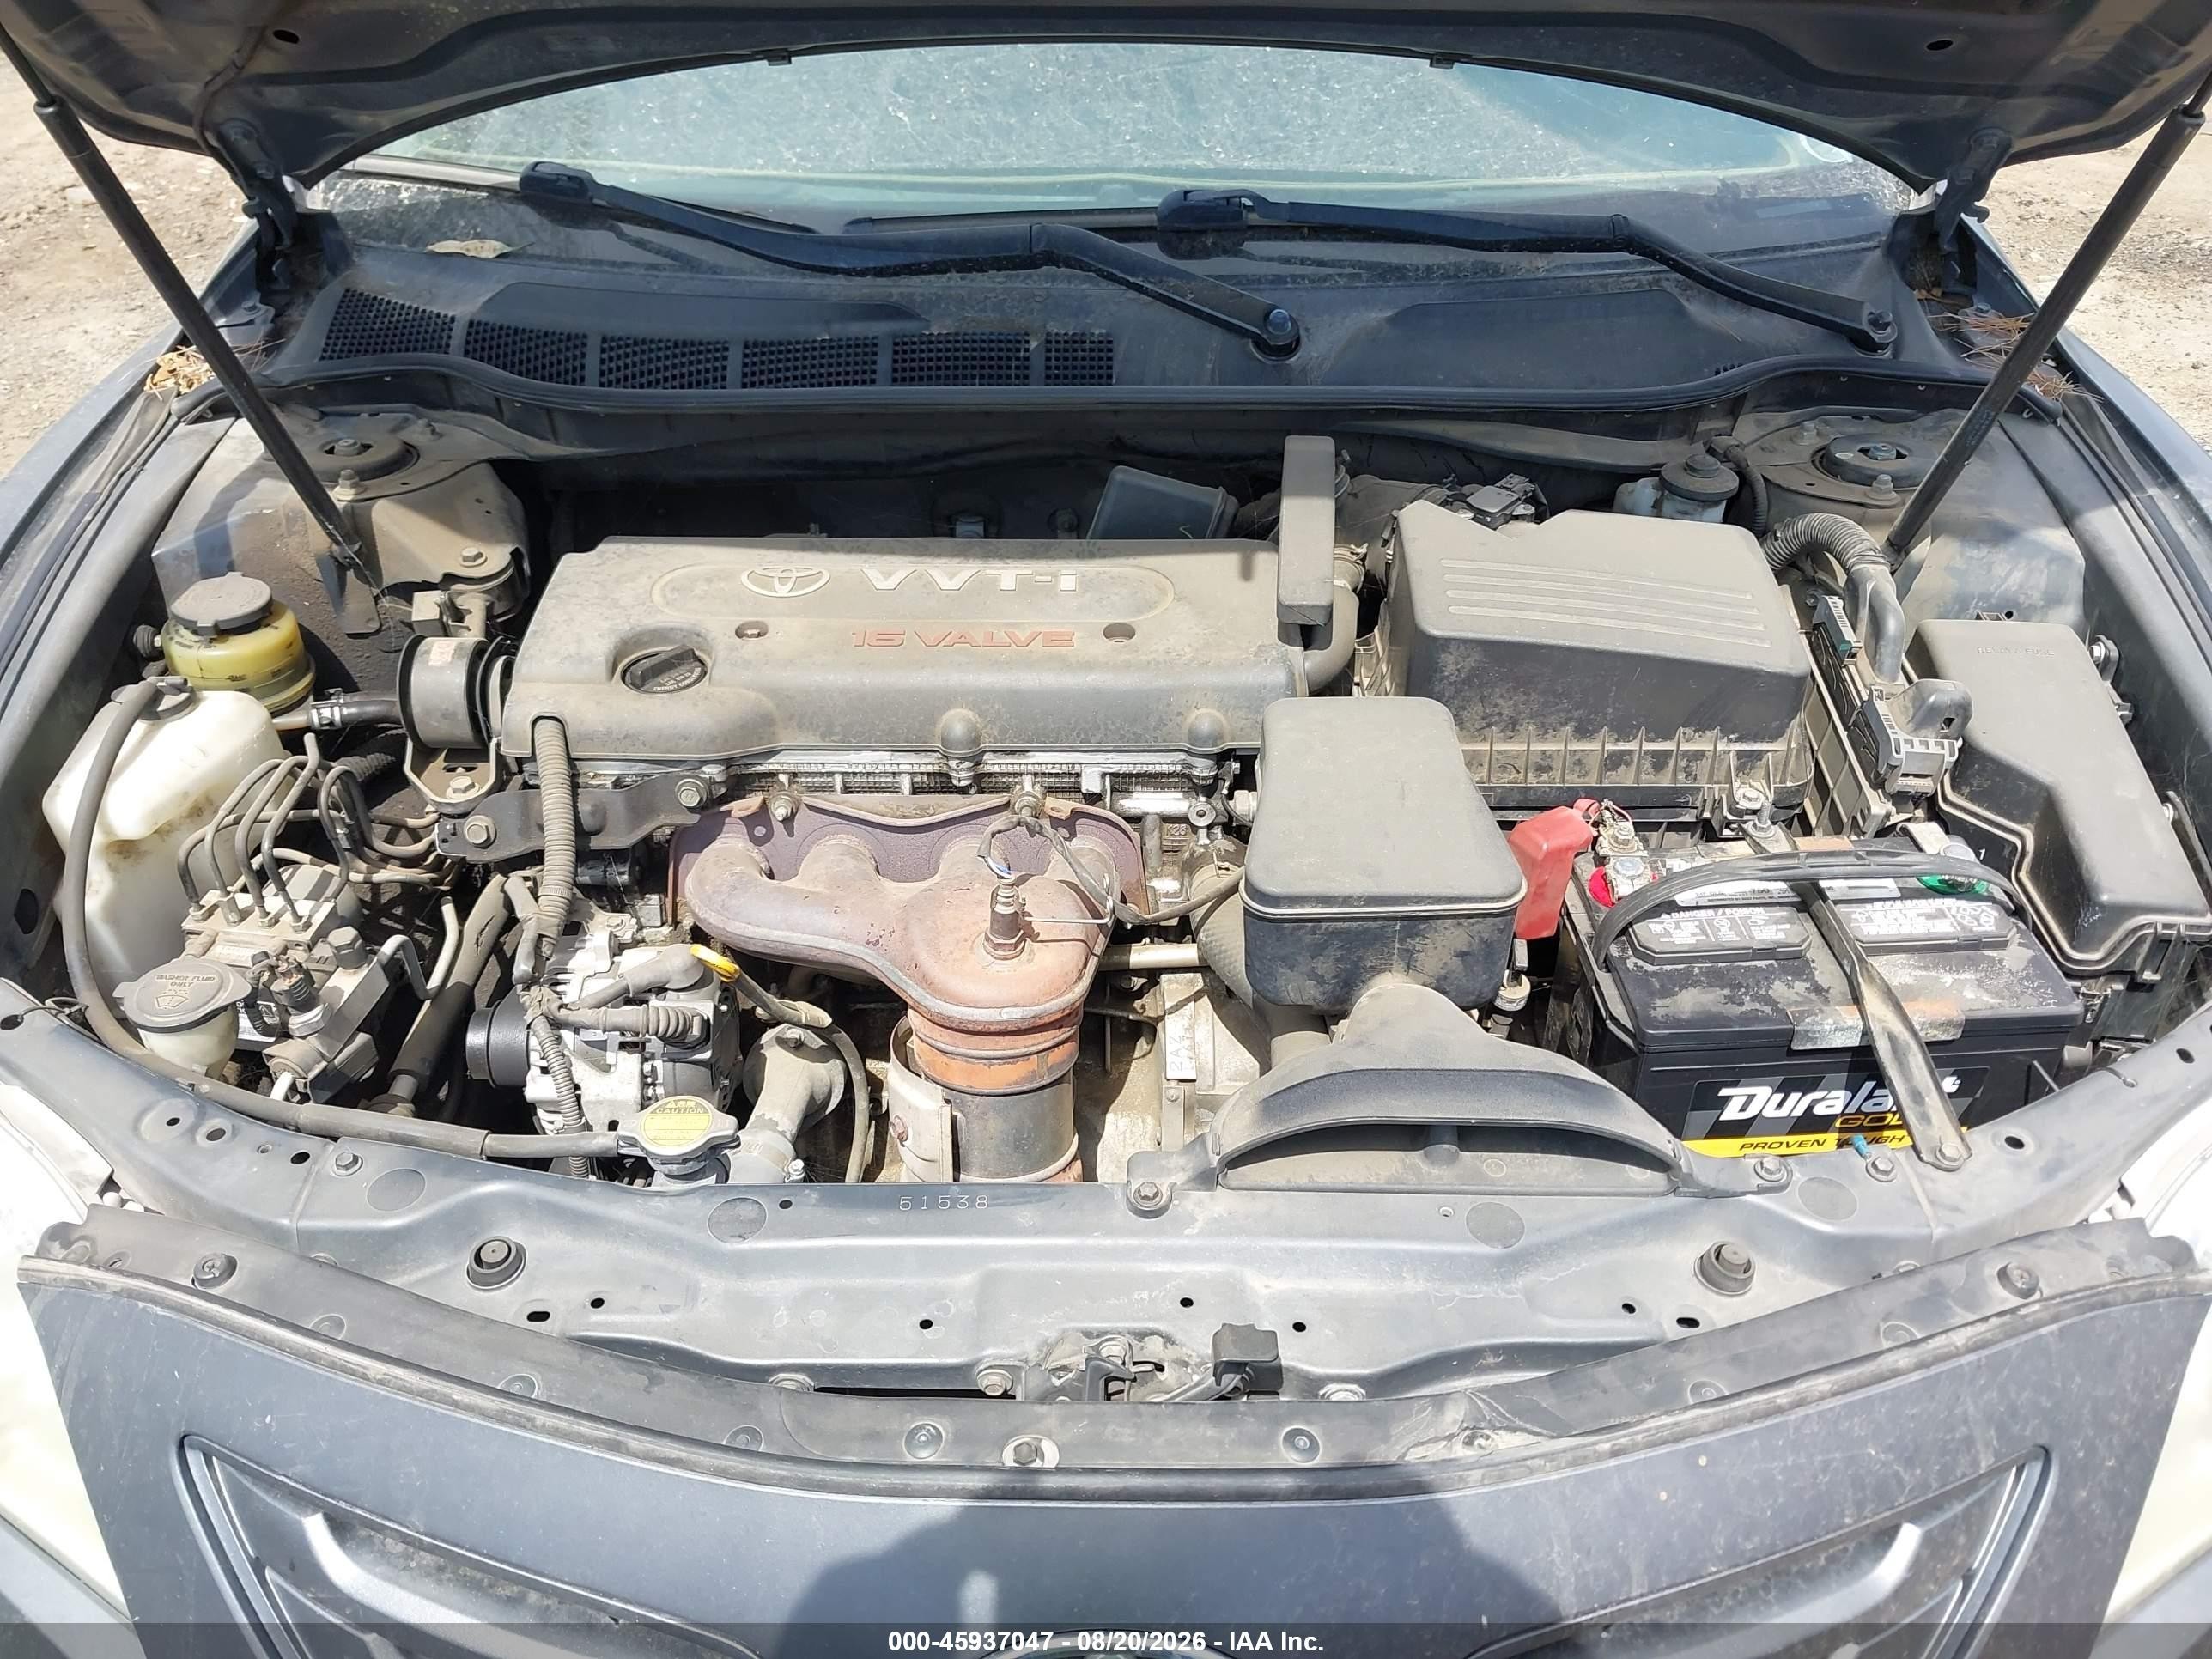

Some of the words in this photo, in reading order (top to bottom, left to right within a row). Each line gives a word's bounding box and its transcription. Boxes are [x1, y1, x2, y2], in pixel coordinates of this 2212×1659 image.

[860, 568, 1078, 592] VVT-i
[851, 629, 906, 647] 16
[914, 630, 1075, 647] VALVE
[1717, 1075, 1960, 1121] Duralat
[1834, 1113, 1905, 1128] GOL
[1739, 1139, 1826, 1151] PROVEN
[1835, 1134, 1906, 1149] TUGH
[899, 1194, 989, 1211] 51538
